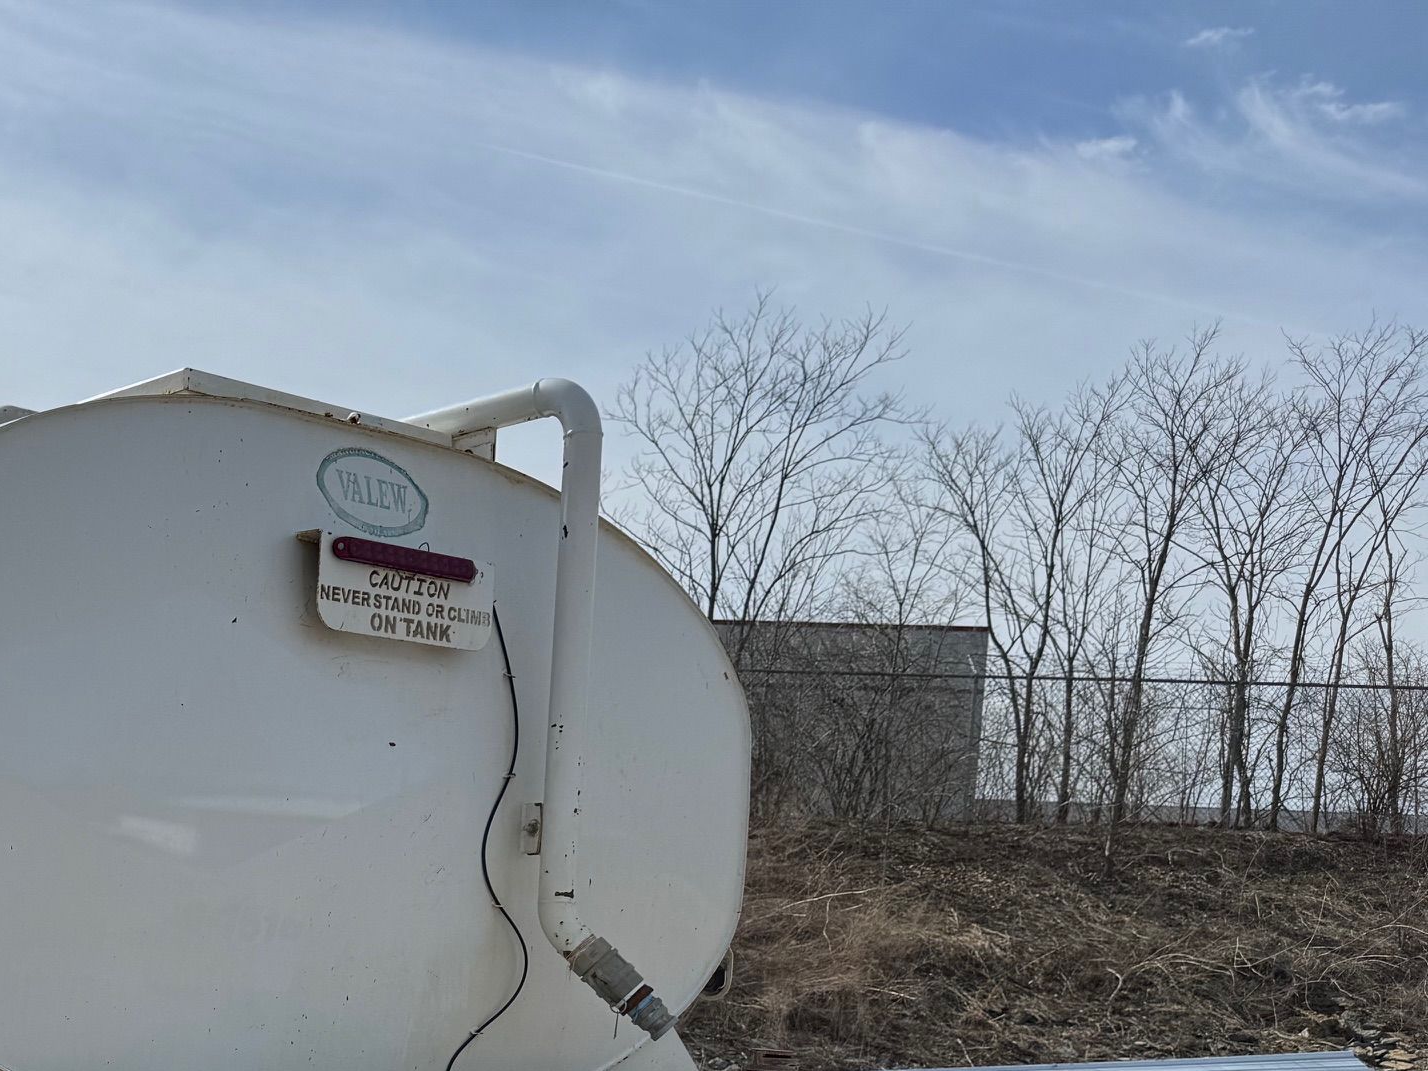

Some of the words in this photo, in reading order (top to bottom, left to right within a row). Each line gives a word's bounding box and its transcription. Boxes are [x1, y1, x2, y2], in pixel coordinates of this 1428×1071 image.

[335, 468, 408, 514] VALEW
[369, 570, 451, 601] CAUTION
[320, 584, 372, 608] NEVER
[373, 595, 421, 615] STAND
[426, 602, 445, 620] OR
[448, 606, 491, 628] CLIMB
[370, 612, 397, 634] ON
[401, 616, 452, 643] TANK
